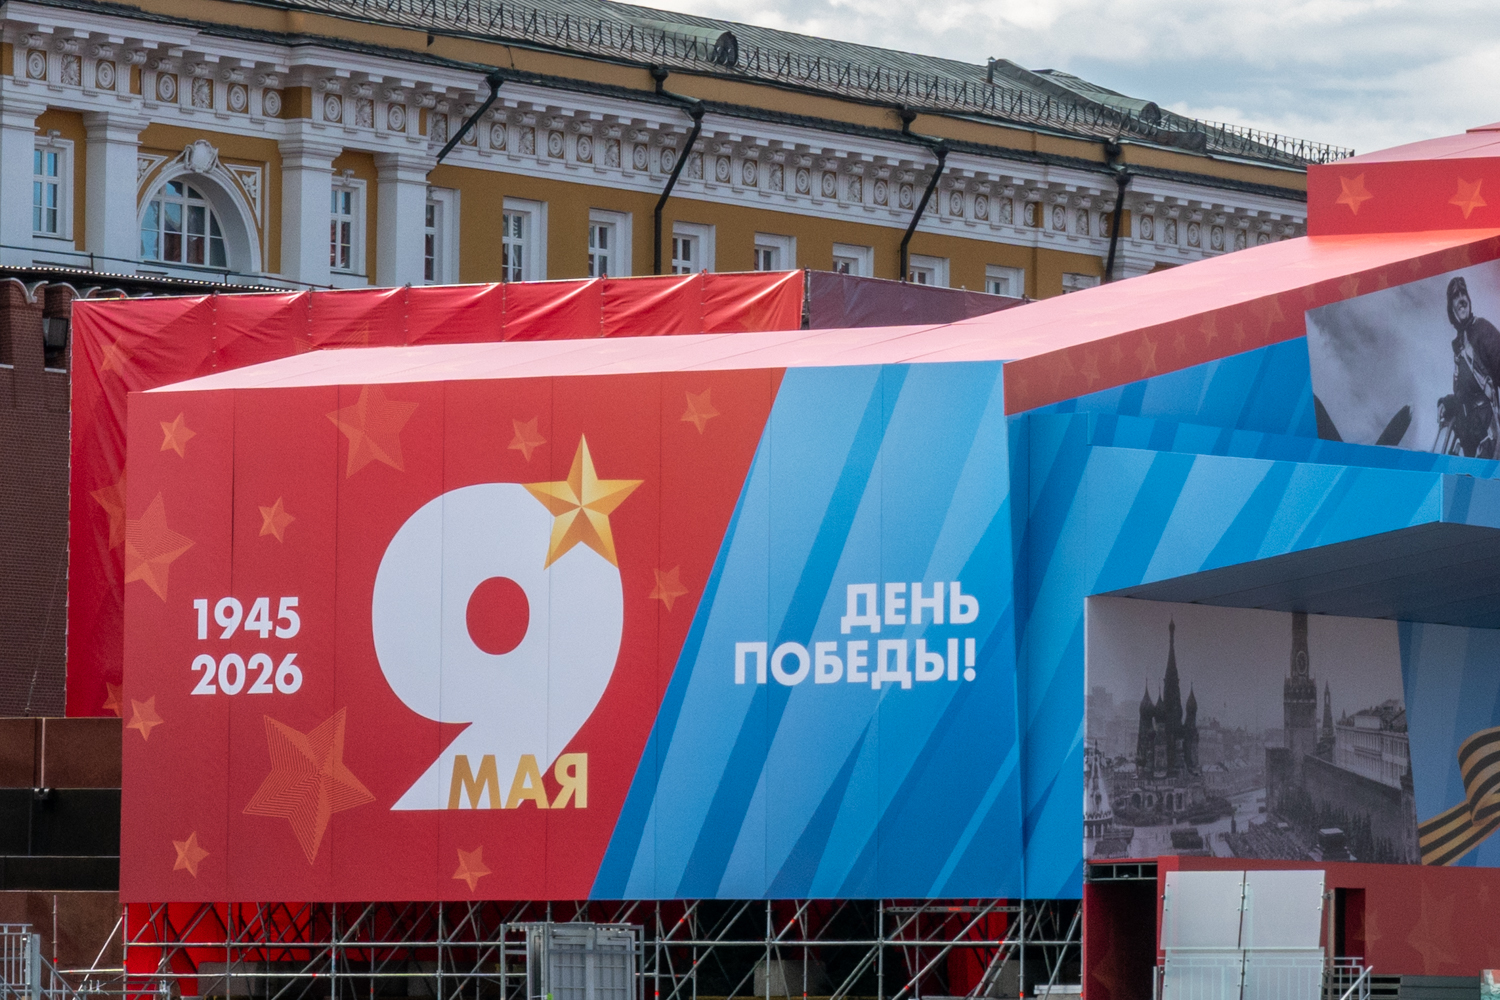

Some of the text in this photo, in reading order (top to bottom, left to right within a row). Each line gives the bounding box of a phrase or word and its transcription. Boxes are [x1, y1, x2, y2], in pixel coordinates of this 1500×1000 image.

[193, 597, 301, 640] 1945
[840, 582, 980, 634] ДЕНЬ
[372, 482, 624, 811] 9 МАЯ
[734, 638, 977, 690] ПОБЕДЫ!
[191, 653, 303, 695] 2026
